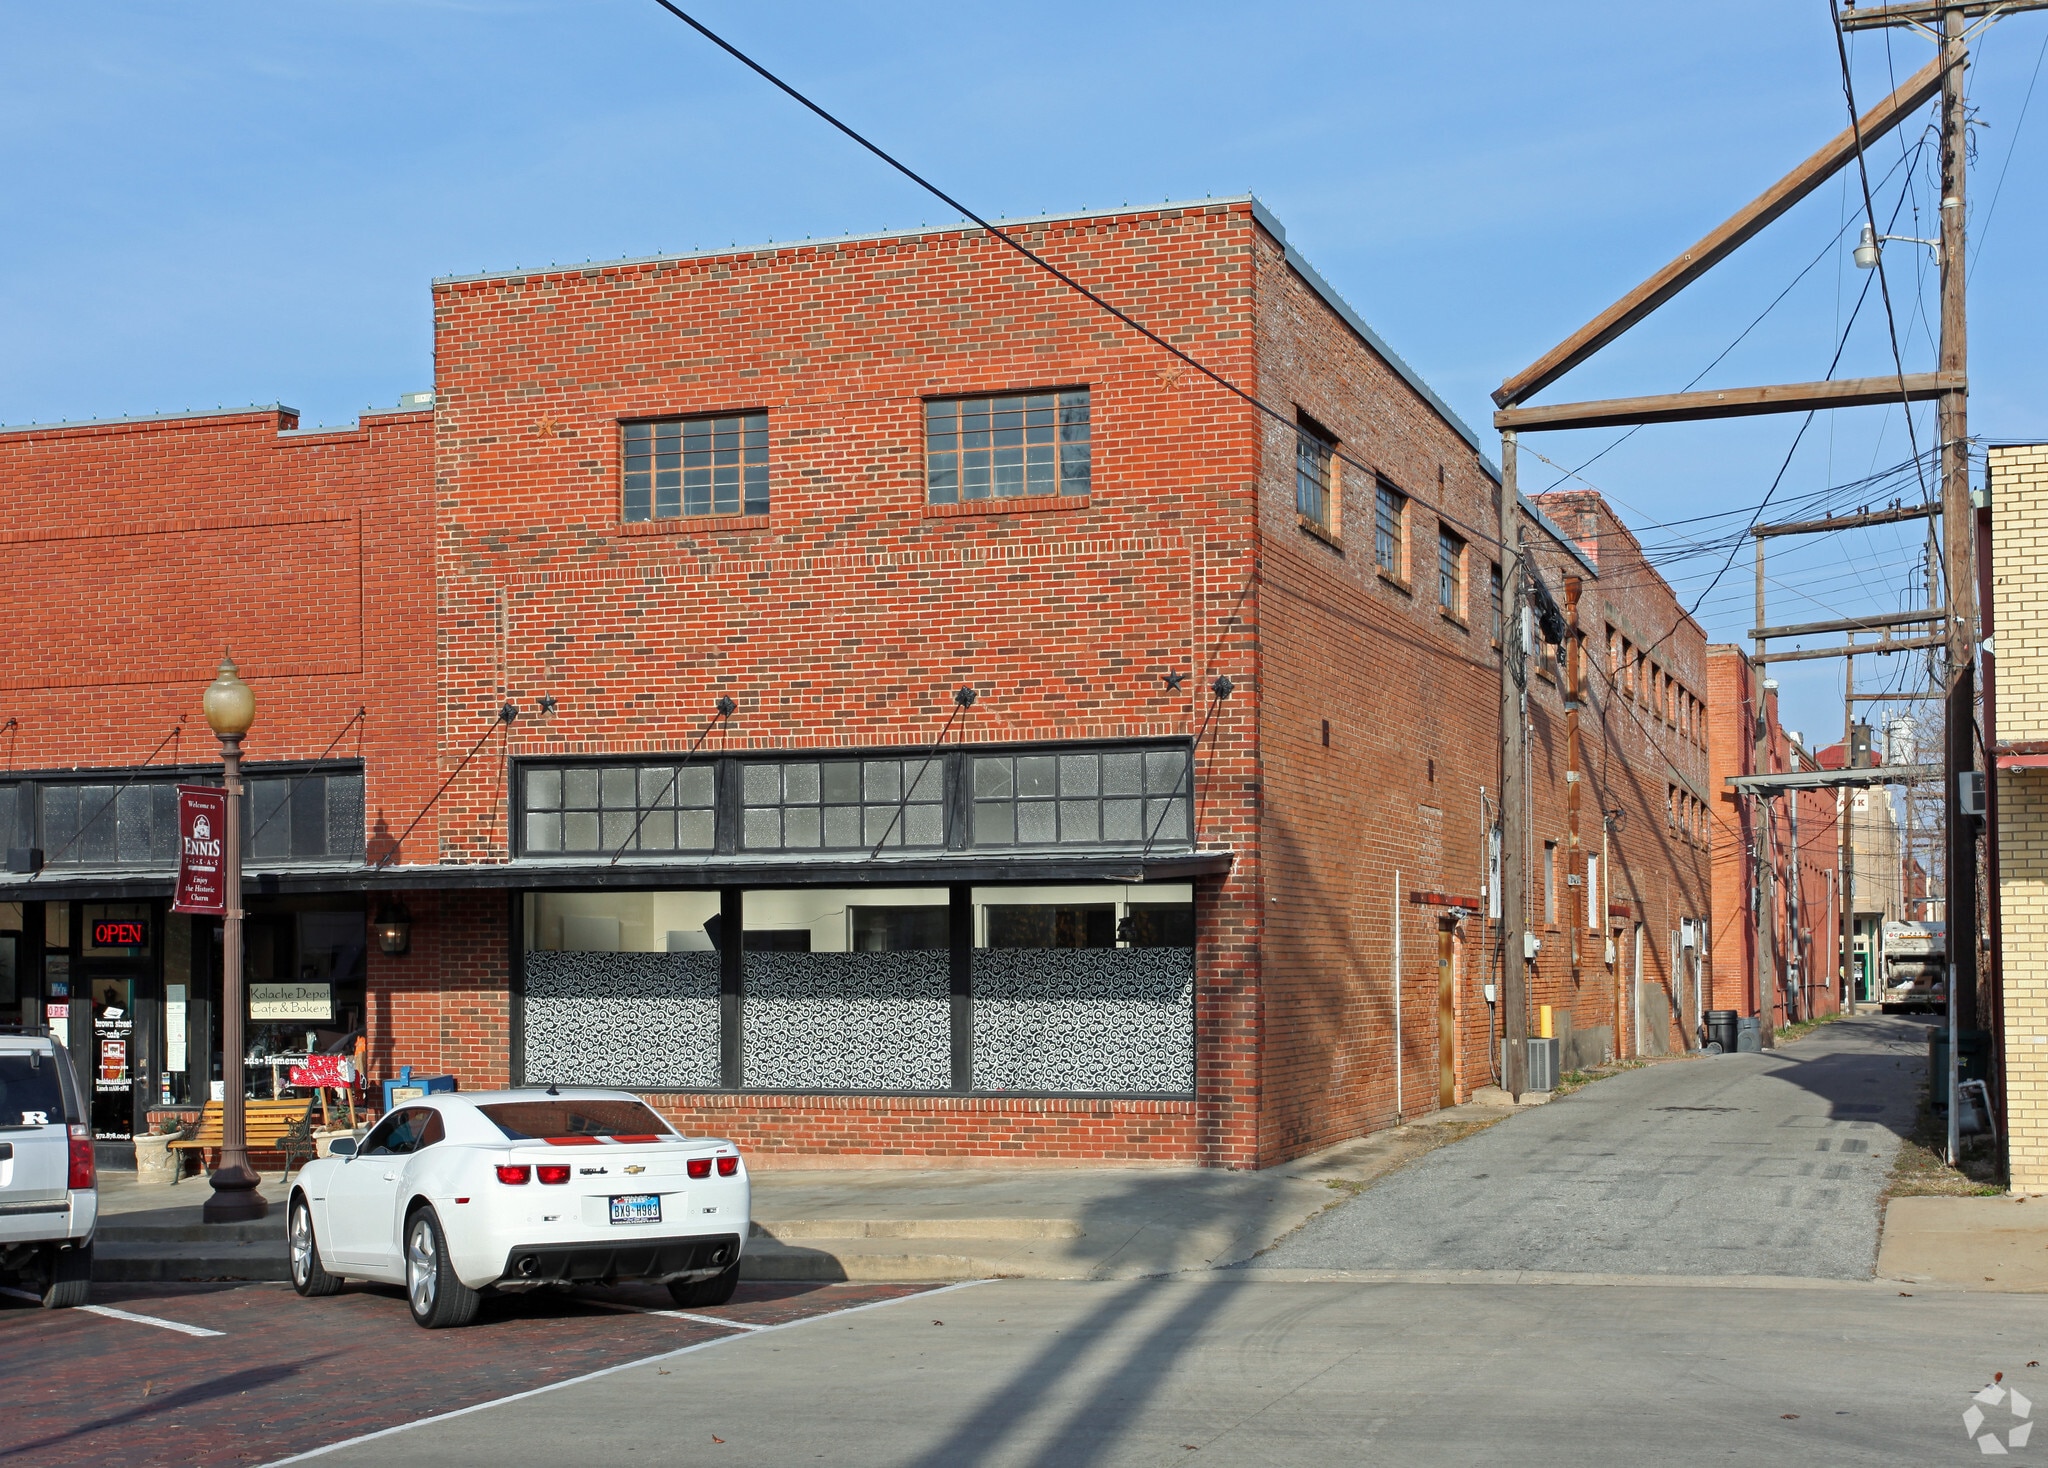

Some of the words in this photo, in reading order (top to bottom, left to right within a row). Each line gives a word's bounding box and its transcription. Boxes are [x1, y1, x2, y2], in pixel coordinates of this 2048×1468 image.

[188, 801, 209, 809] Welcome
[184, 837, 220, 857] ENNIS
[193, 876, 208, 885] Enjoy
[195, 884, 215, 893] Historic
[191, 893, 209, 901] Charm
[95, 923, 143, 943] OPEN
[250, 987, 294, 1000] Kolache
[296, 987, 330, 1002] Depot
[251, 1001, 278, 1016] Cafe
[279, 1001, 289, 1013] &
[291, 1001, 331, 1016] Bakery
[95, 1018, 114, 1028] brown
[115, 1020, 132, 1028] street
[22, 1111, 49, 1125] R
